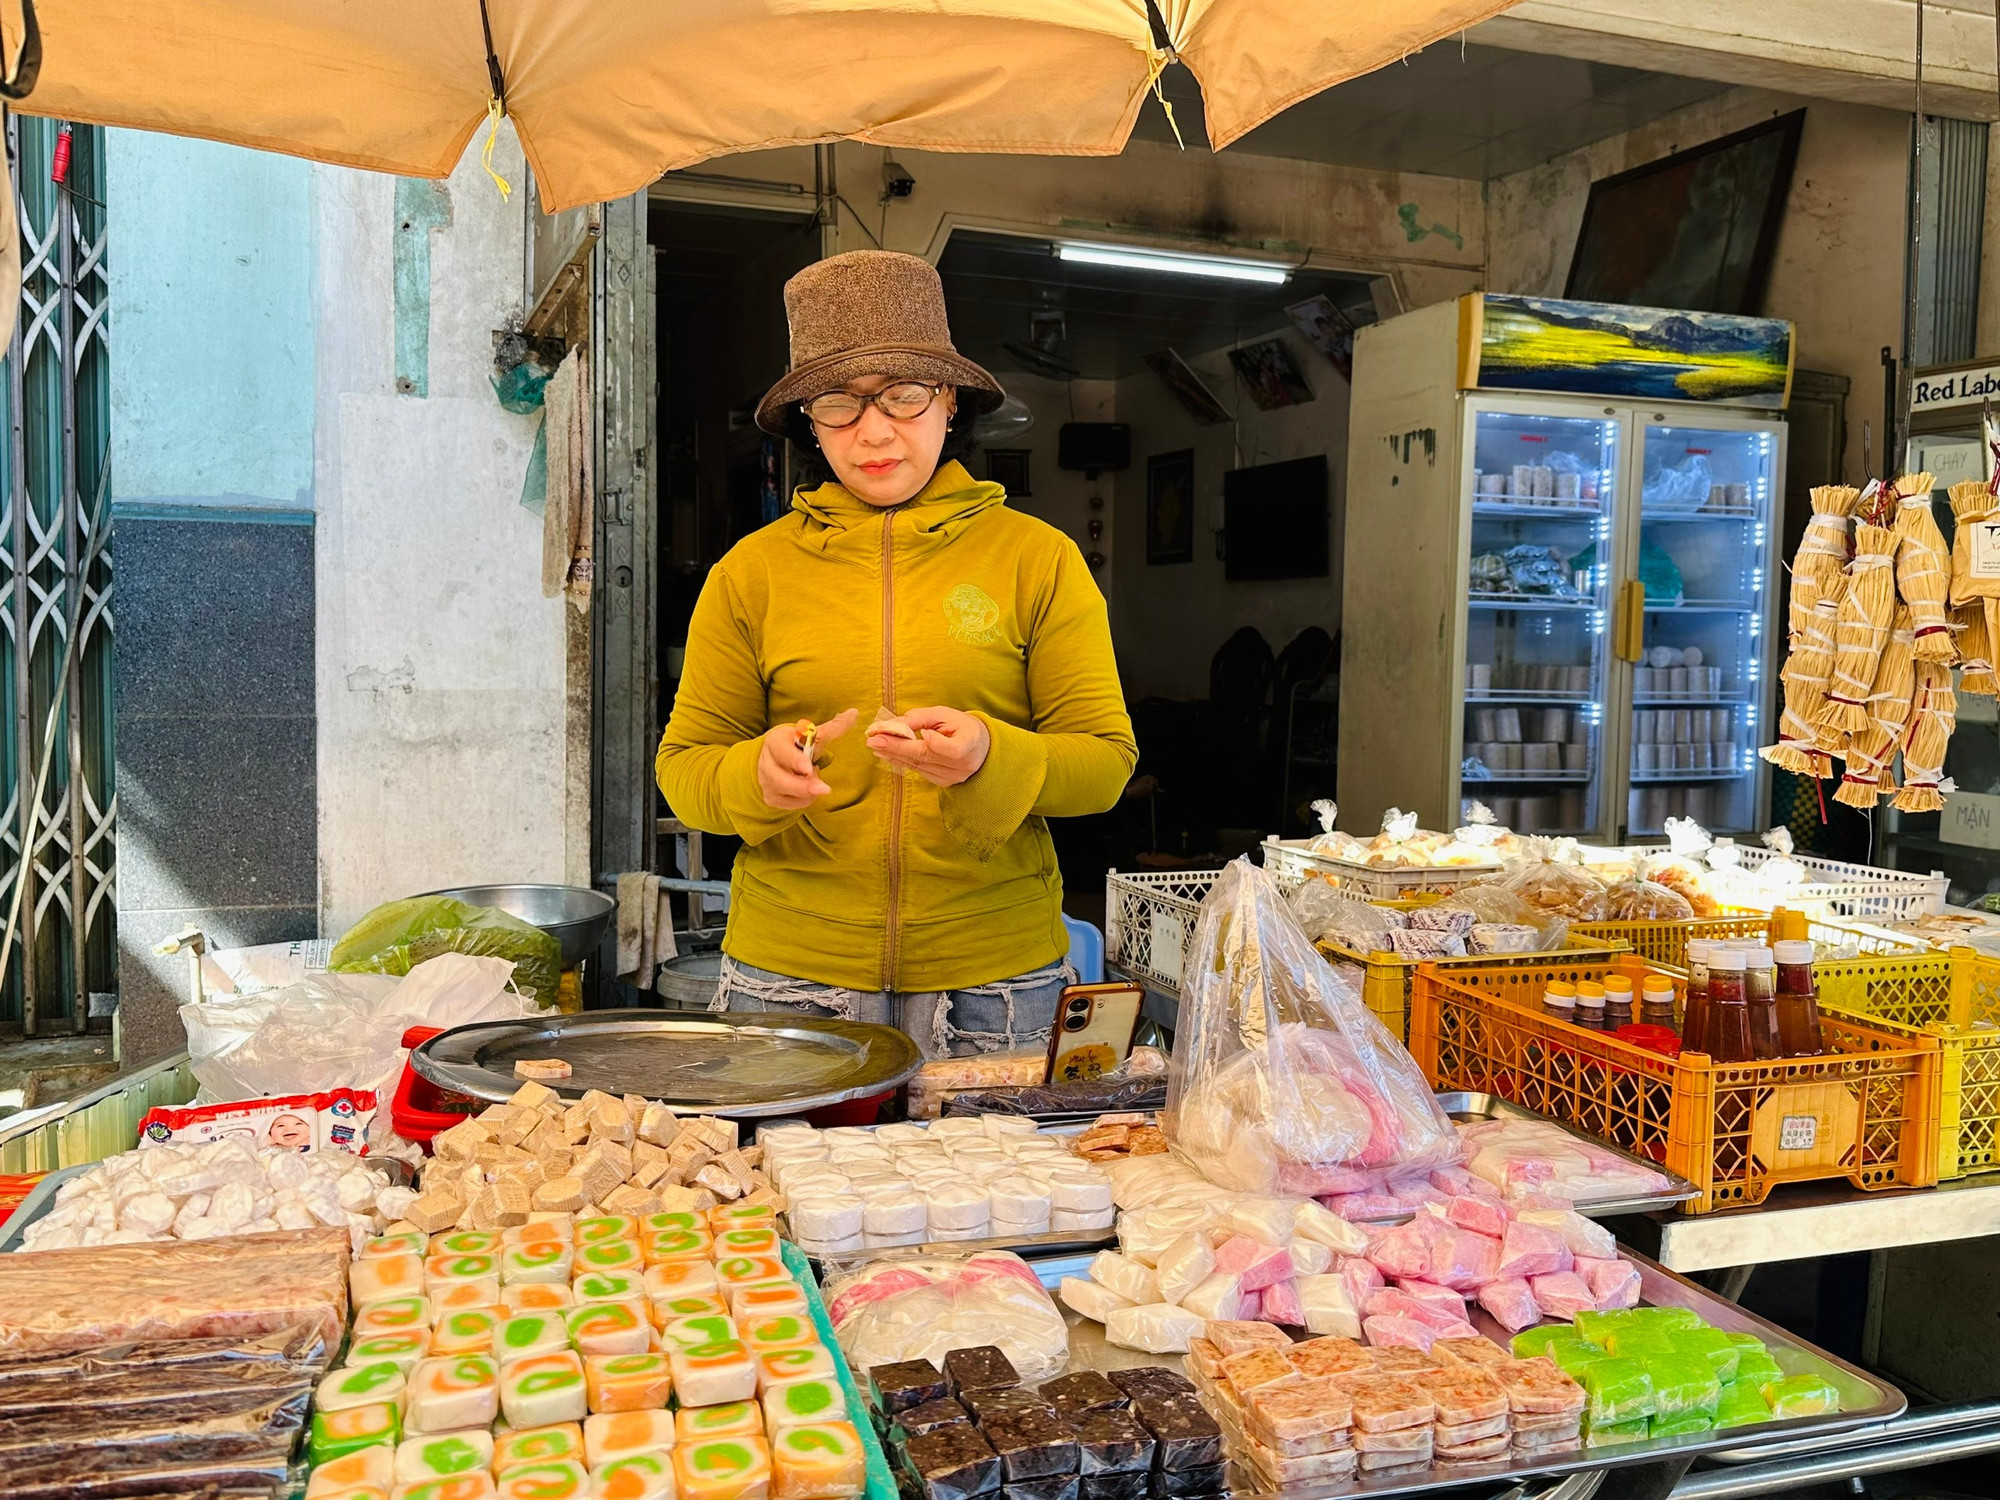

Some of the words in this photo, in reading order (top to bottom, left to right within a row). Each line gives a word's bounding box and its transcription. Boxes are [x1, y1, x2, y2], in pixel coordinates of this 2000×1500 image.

[1914, 378, 1955, 404] Red
[1933, 452, 1968, 472] CHAY
[948, 625, 1003, 645] VERSACE
